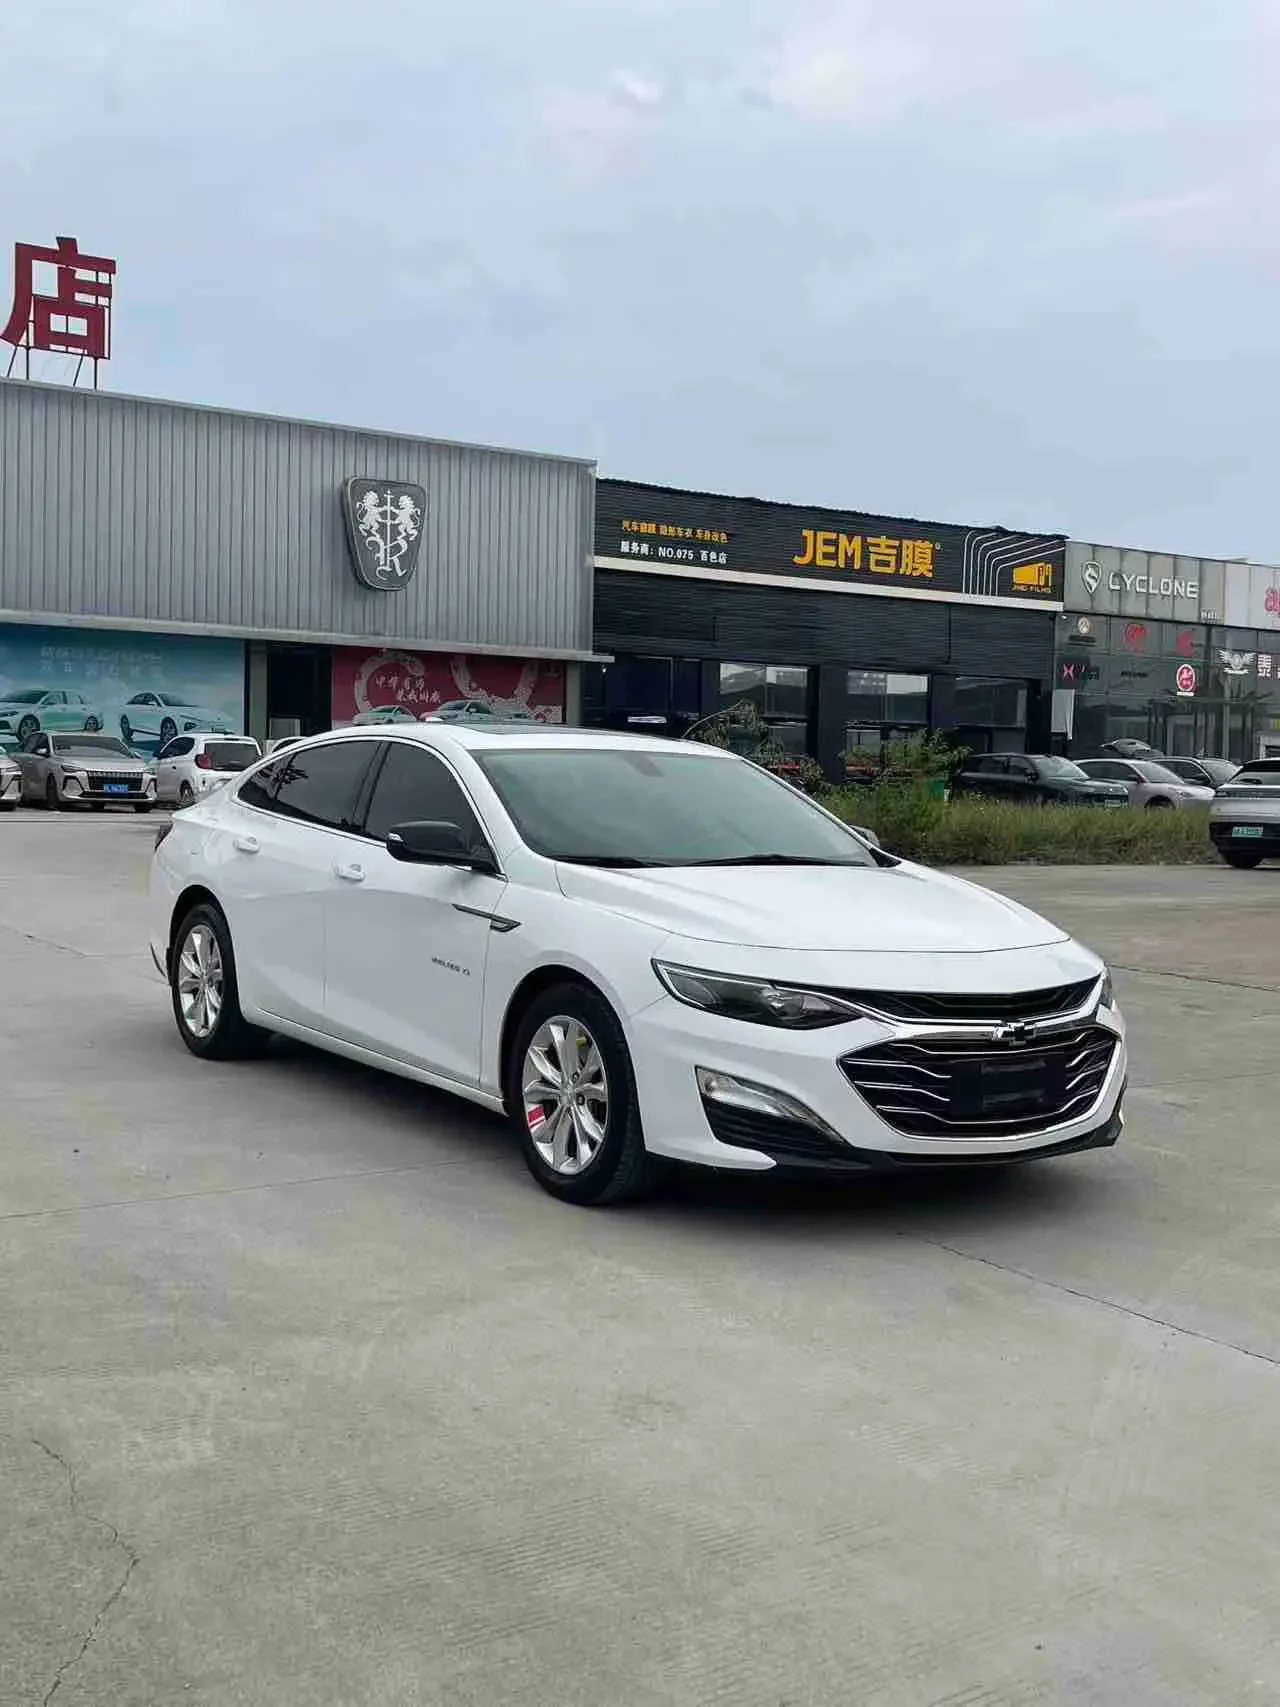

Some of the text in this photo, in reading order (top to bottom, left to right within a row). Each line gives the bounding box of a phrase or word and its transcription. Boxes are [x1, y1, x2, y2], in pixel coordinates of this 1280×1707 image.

[0, 236, 115, 357] 店
[658, 547, 694, 560] NO.075
[700, 550, 728, 564] 百色店
[792, 529, 933, 577] JEM 吉膜
